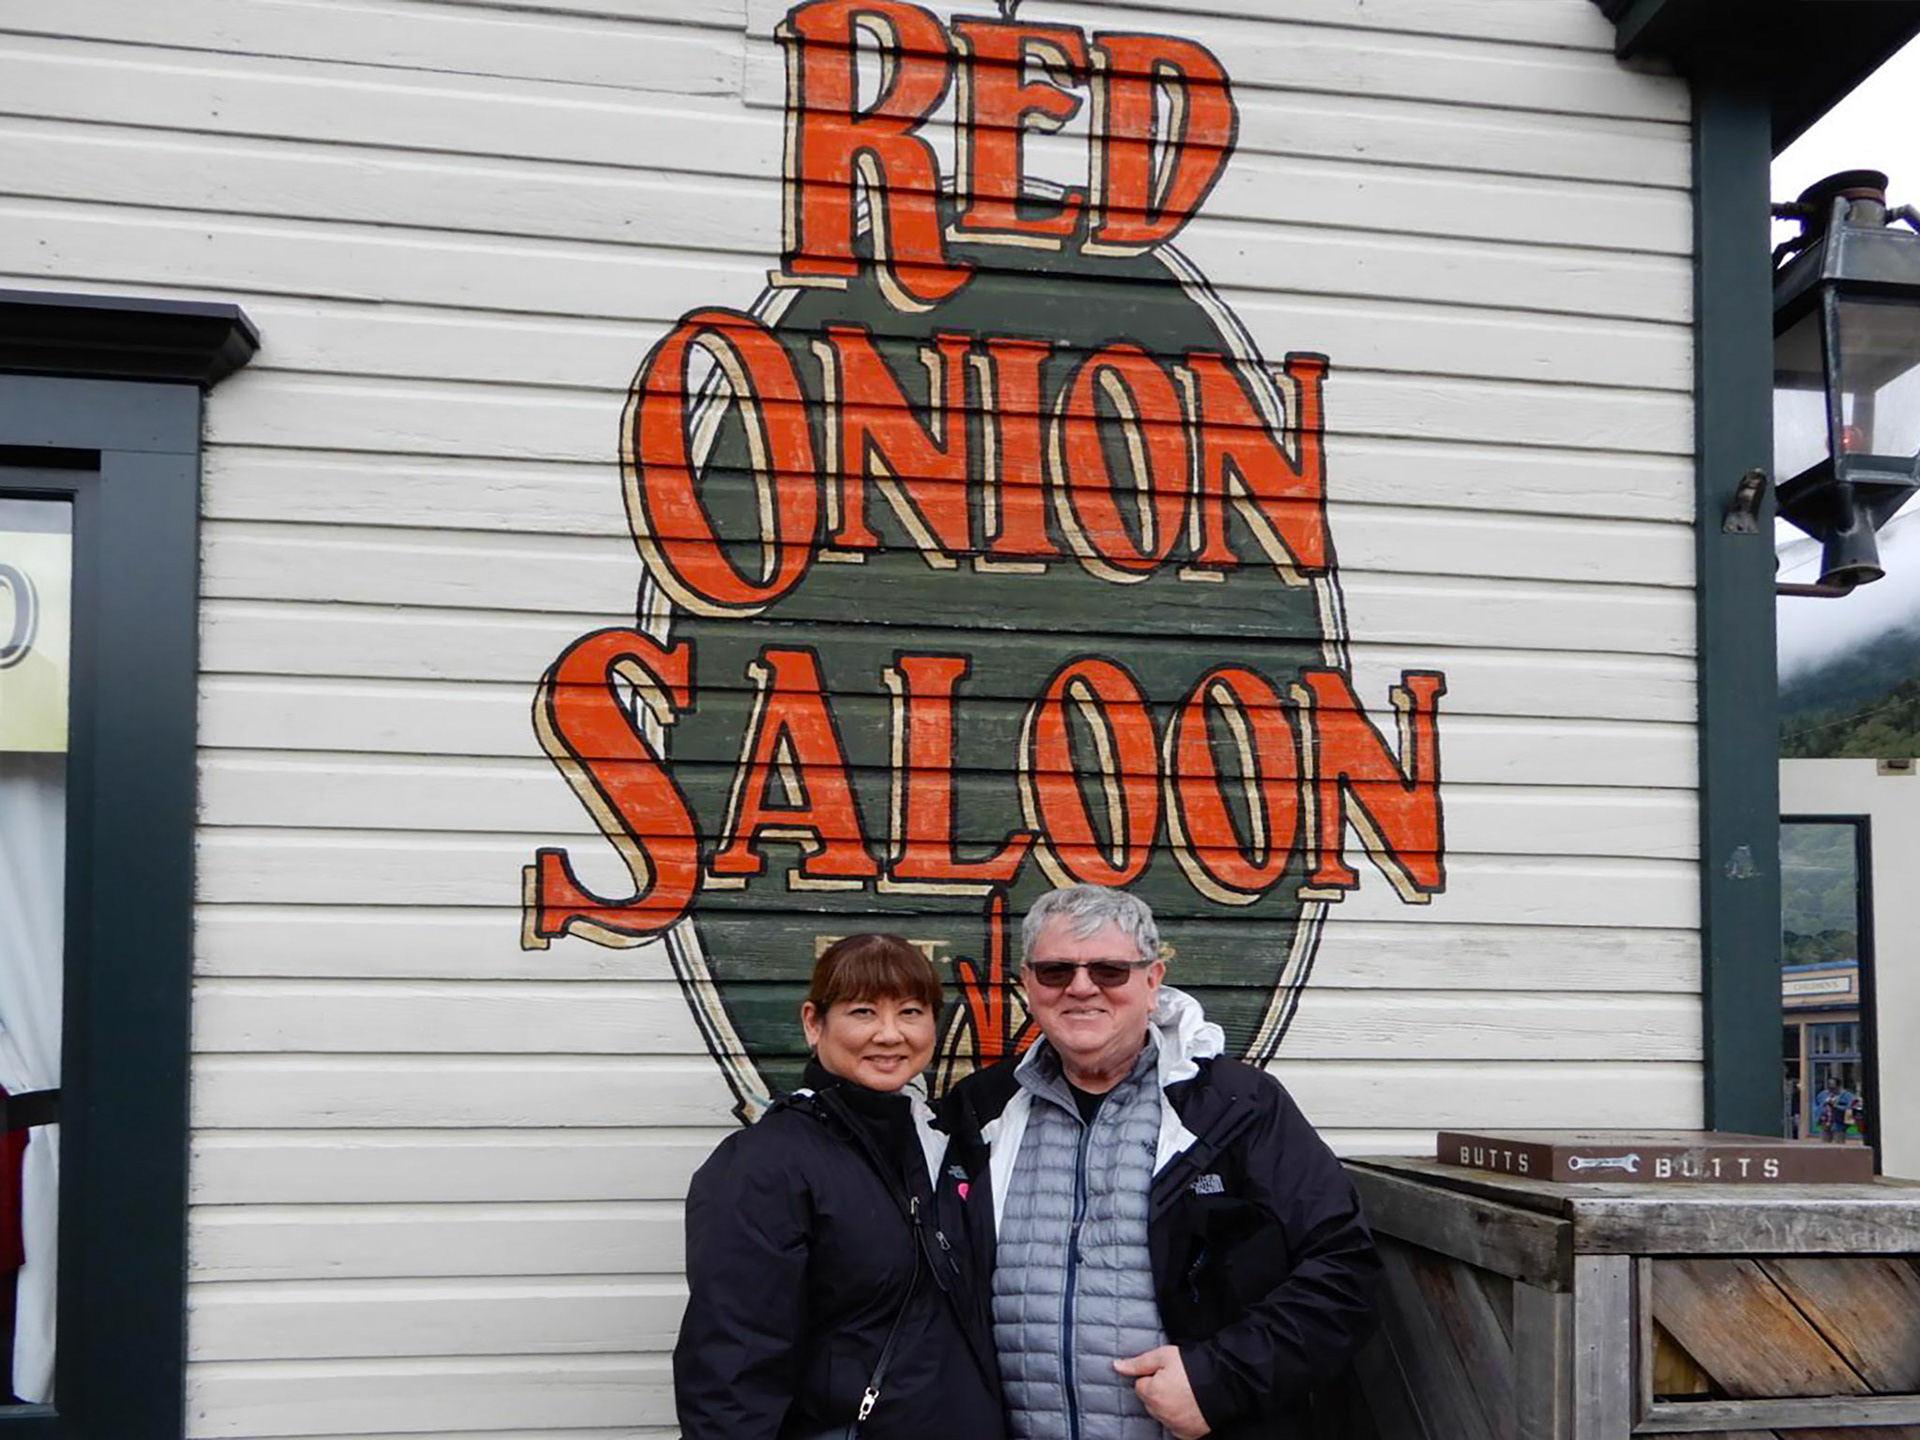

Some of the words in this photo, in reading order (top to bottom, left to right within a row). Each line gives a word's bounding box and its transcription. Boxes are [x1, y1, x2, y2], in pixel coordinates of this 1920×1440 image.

[768, 0, 1239, 312] RED
[620, 307, 1330, 619] ONION
[522, 627, 1447, 950] SALOON
[1459, 1145, 1529, 1173] BUTTS
